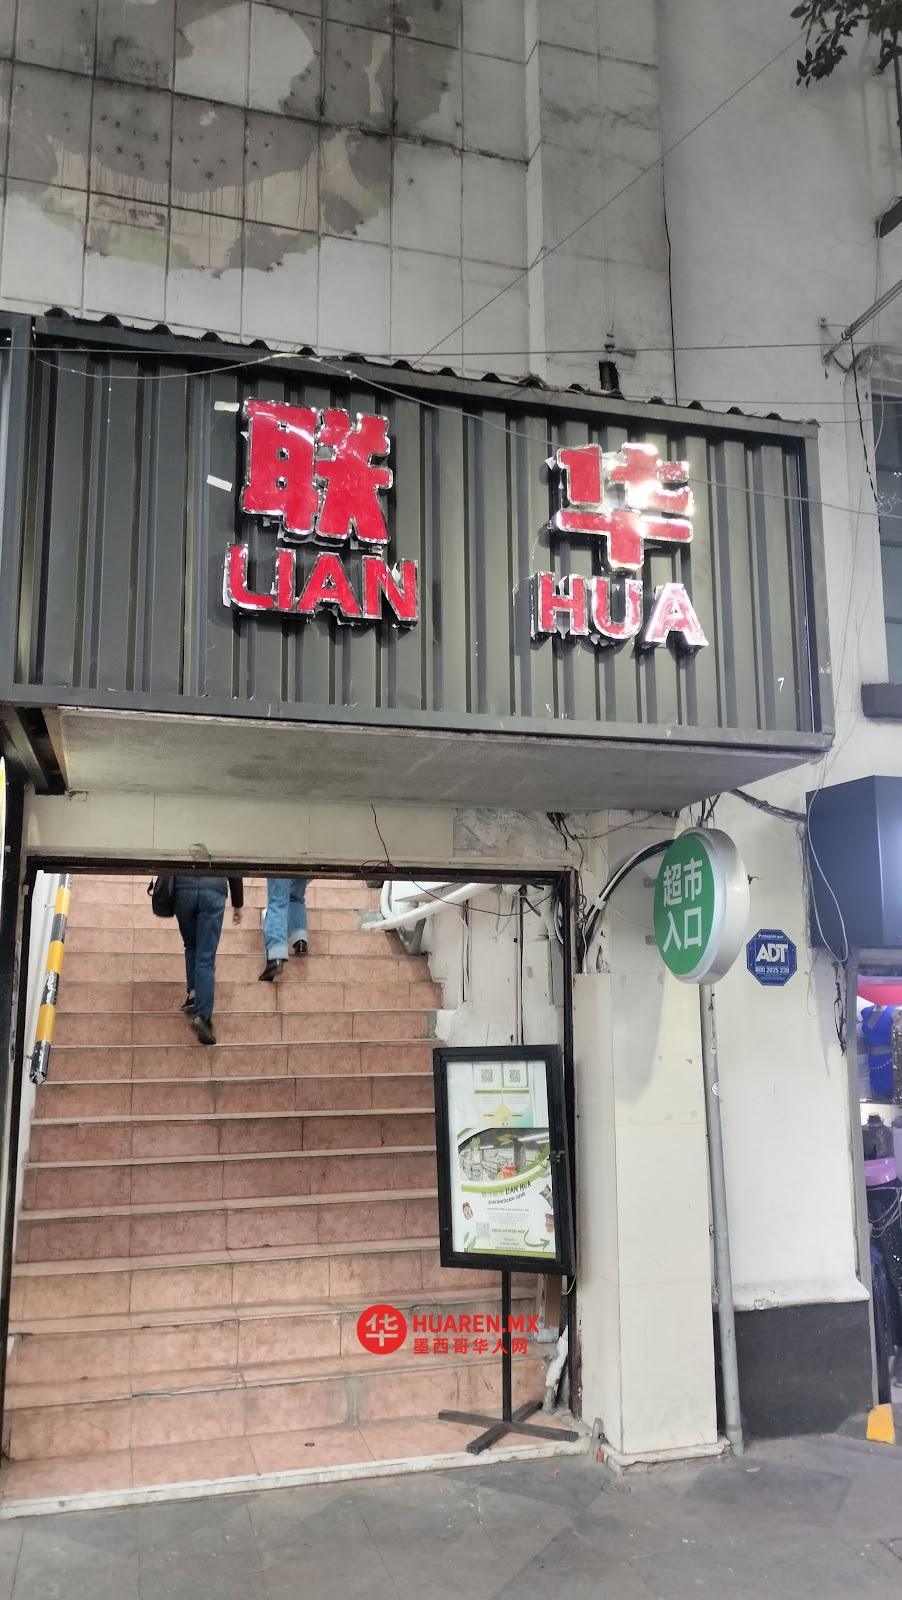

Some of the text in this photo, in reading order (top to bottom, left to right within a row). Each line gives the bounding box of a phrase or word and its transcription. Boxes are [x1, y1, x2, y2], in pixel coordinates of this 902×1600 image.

[240, 397, 693, 571] 联 华
[224, 543, 708, 647] LIAN HUA
[663, 857, 703, 907] 超市
[662, 906, 702, 953] 入口
[755, 943, 788, 963] ADT
